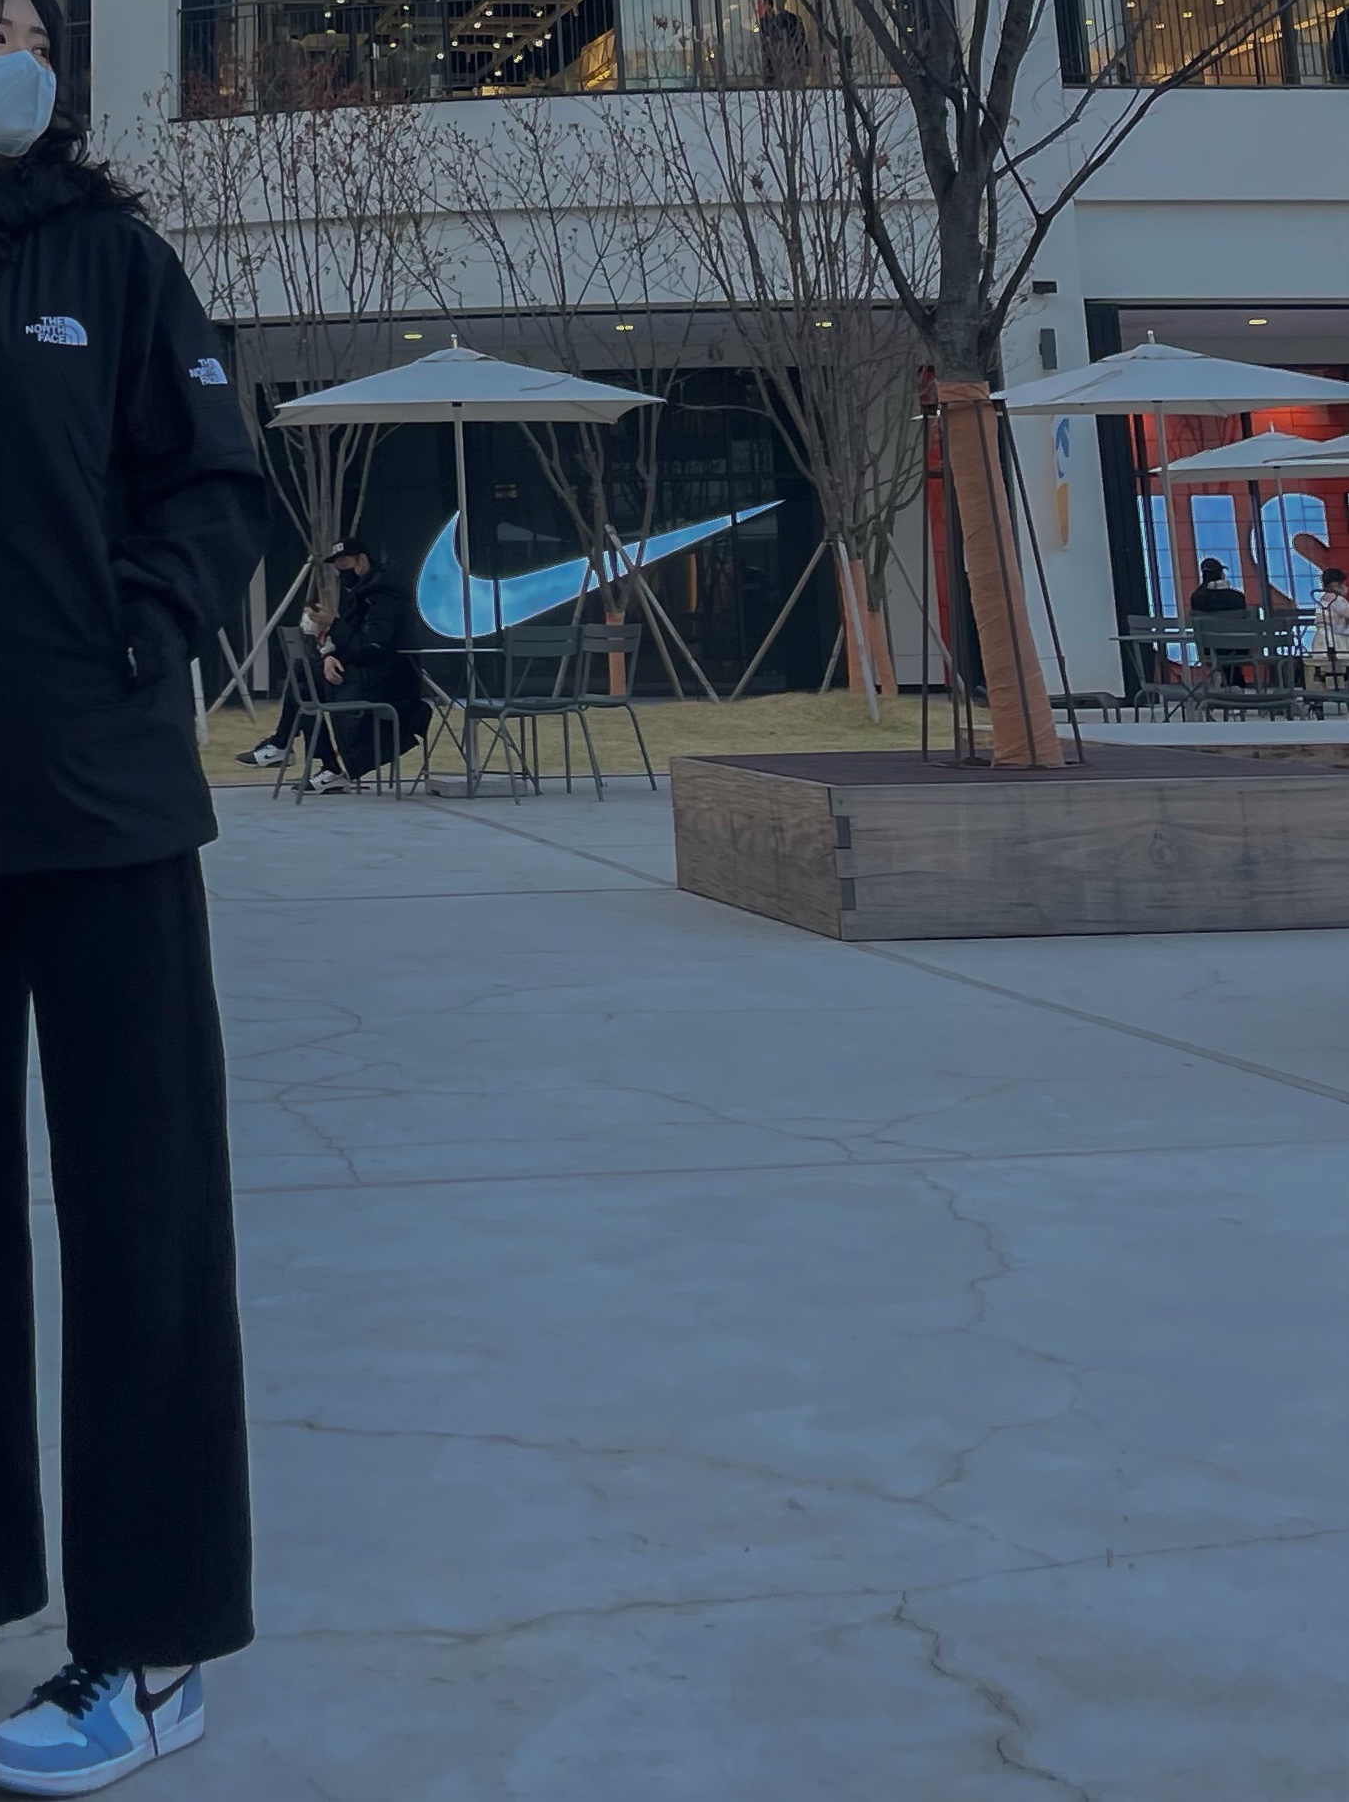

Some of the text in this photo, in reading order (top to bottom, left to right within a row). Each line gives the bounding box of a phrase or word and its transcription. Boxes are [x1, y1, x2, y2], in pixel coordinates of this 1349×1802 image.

[41, 316, 65, 326] THE
[25, 323, 65, 334] NORTH
[37, 332, 66, 344] FACE
